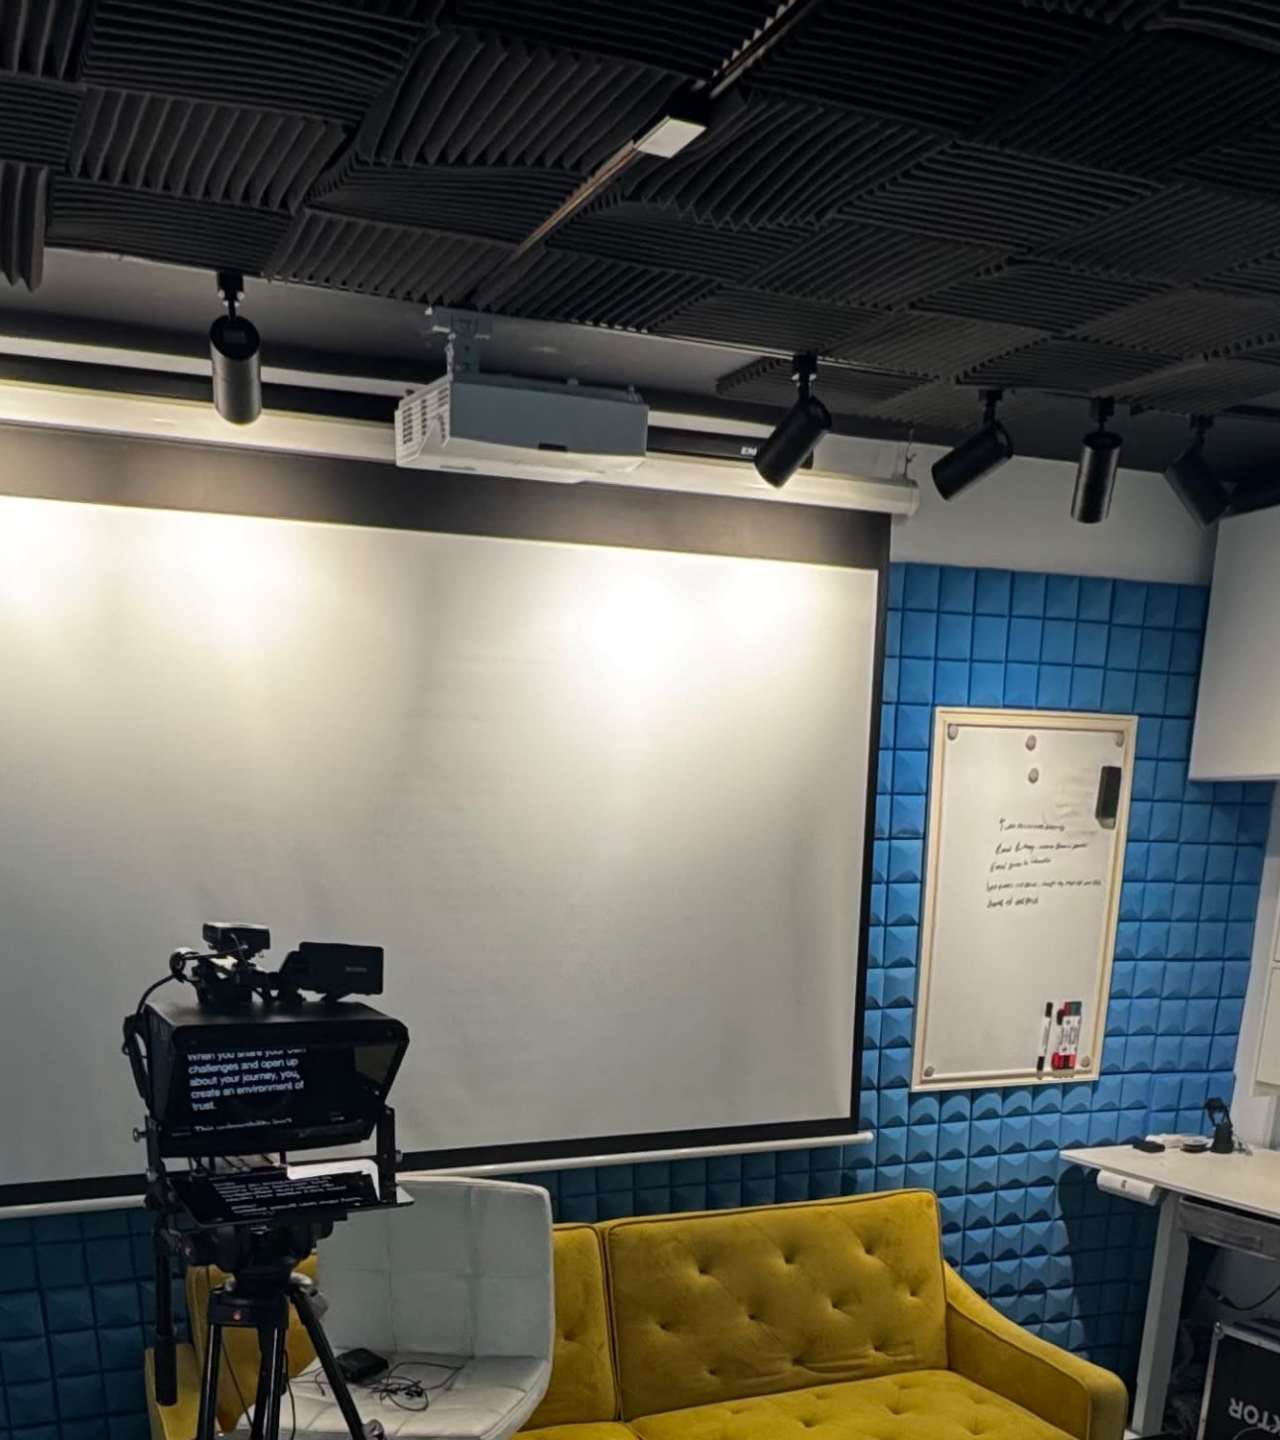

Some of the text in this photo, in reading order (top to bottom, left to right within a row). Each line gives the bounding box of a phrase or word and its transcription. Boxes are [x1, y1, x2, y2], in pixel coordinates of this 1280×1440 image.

[188, 1058, 299, 1075] challenges and open up
[190, 1076, 217, 1087] about
[220, 1075, 240, 1086] your
[191, 1080, 304, 1099] create an environment of
[192, 1101, 216, 1111] trust.
